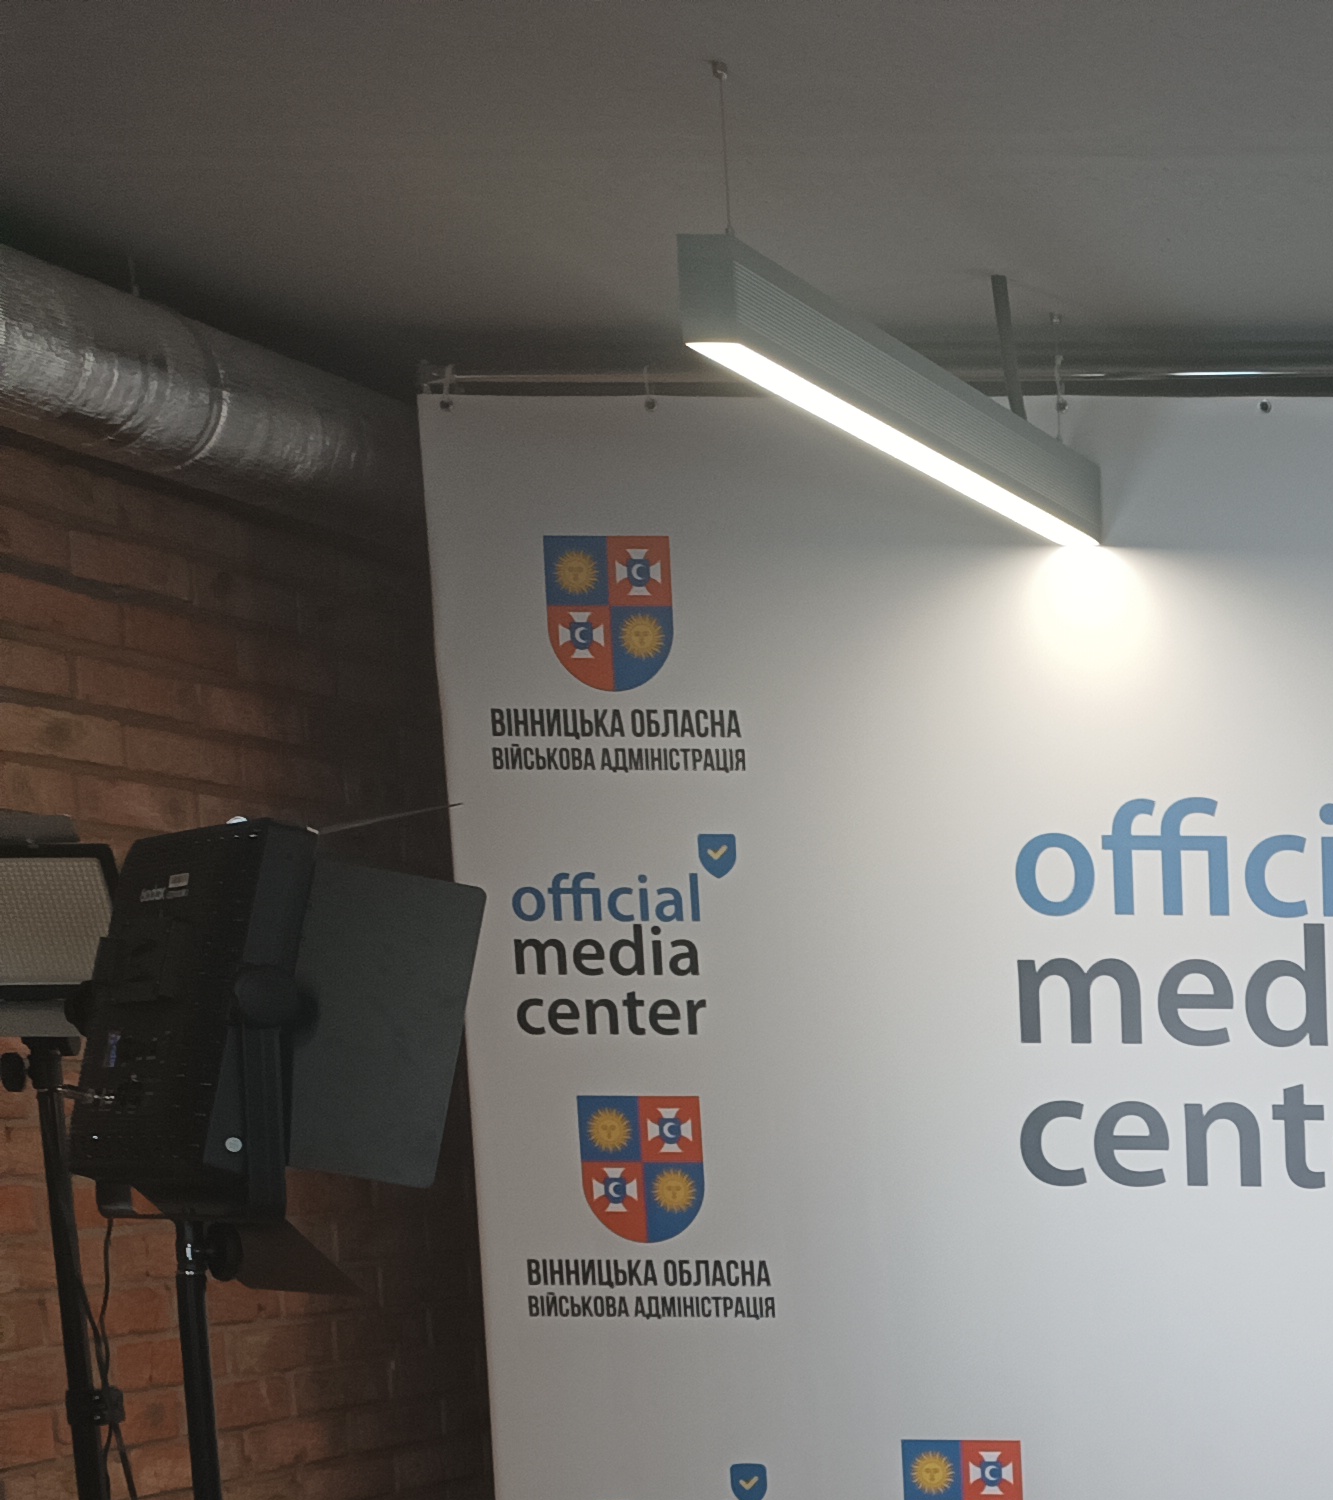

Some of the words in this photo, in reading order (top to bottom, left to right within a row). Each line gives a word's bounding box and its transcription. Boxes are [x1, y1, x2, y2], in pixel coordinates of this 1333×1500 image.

[491, 708, 625, 740] ВІННИЦЬКА
[631, 709, 741, 738] ОБЛАСНА
[492, 744, 596, 770] ВІЙСЬКОВА
[601, 748, 746, 773] АДМІНІСТРАЦІЯ
[512, 872, 700, 922] official
[514, 924, 699, 976] media
[517, 991, 706, 1035] center
[527, 1259, 658, 1289] ВІННИЦЬКА
[664, 1259, 771, 1286] ОБЛАСНА
[528, 1292, 630, 1317] ВІЙСЬКОВА
[635, 1296, 775, 1320] АДМІНІСТРАЦІЯ
